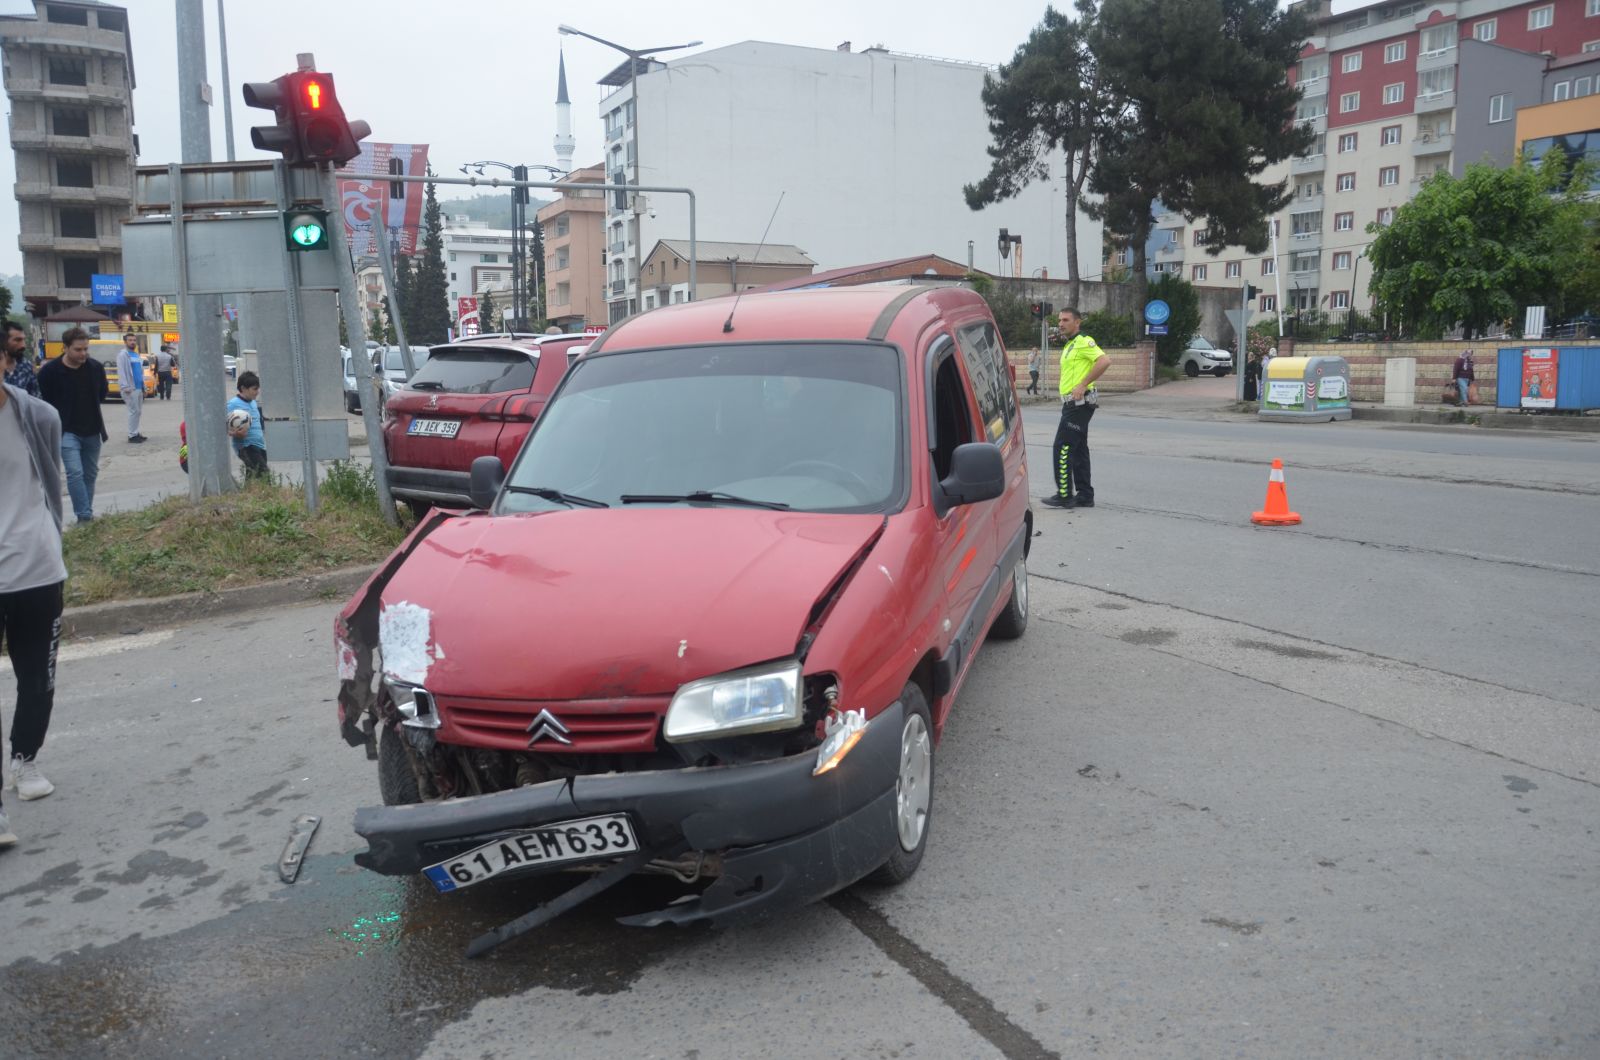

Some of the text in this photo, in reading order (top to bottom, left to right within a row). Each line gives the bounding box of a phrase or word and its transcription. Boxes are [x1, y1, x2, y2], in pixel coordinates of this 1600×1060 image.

[413, 421, 458, 434] 61 AEK 359
[450, 853, 493, 883] 61
[565, 820, 630, 854] 633
